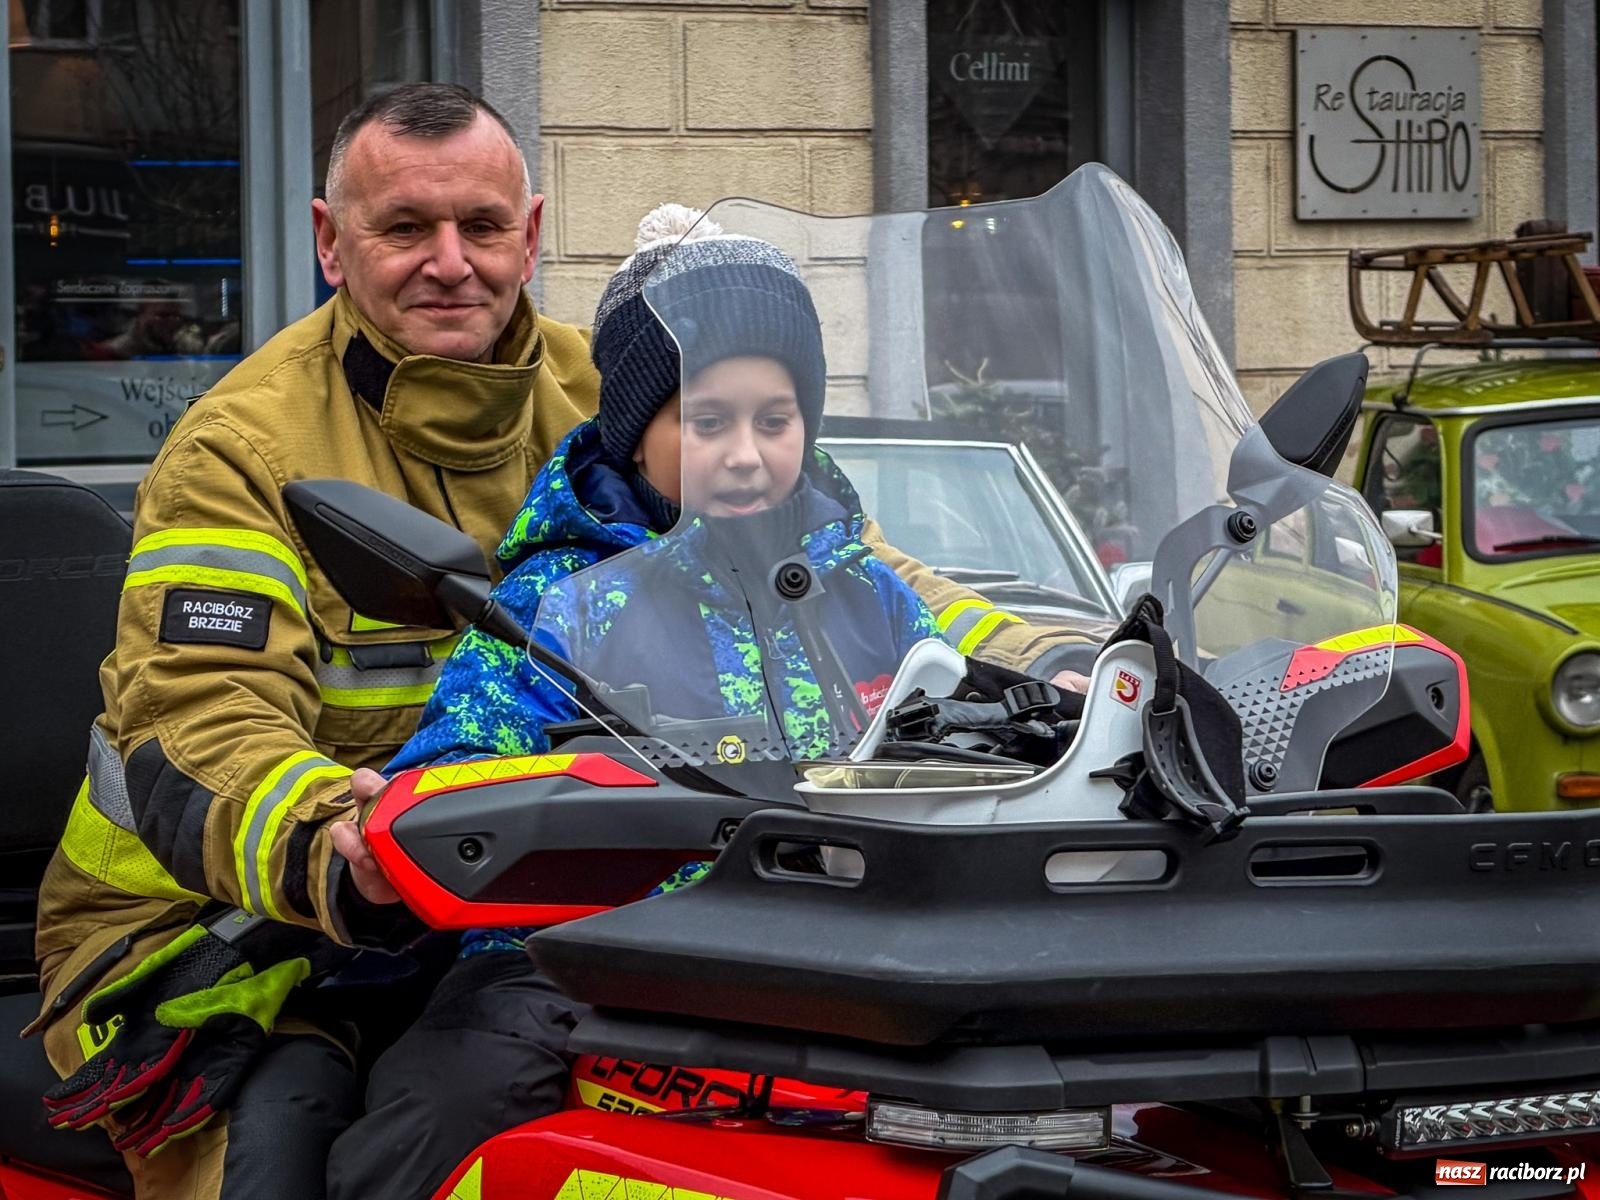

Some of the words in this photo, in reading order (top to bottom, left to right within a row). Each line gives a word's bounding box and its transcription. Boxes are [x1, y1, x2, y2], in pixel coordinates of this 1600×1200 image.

[949, 51, 1031, 81] Cellini
[121, 376, 208, 408] Wejści
[182, 600, 254, 620] RACIBÓRZ
[188, 616, 243, 632] BRZEZIE
